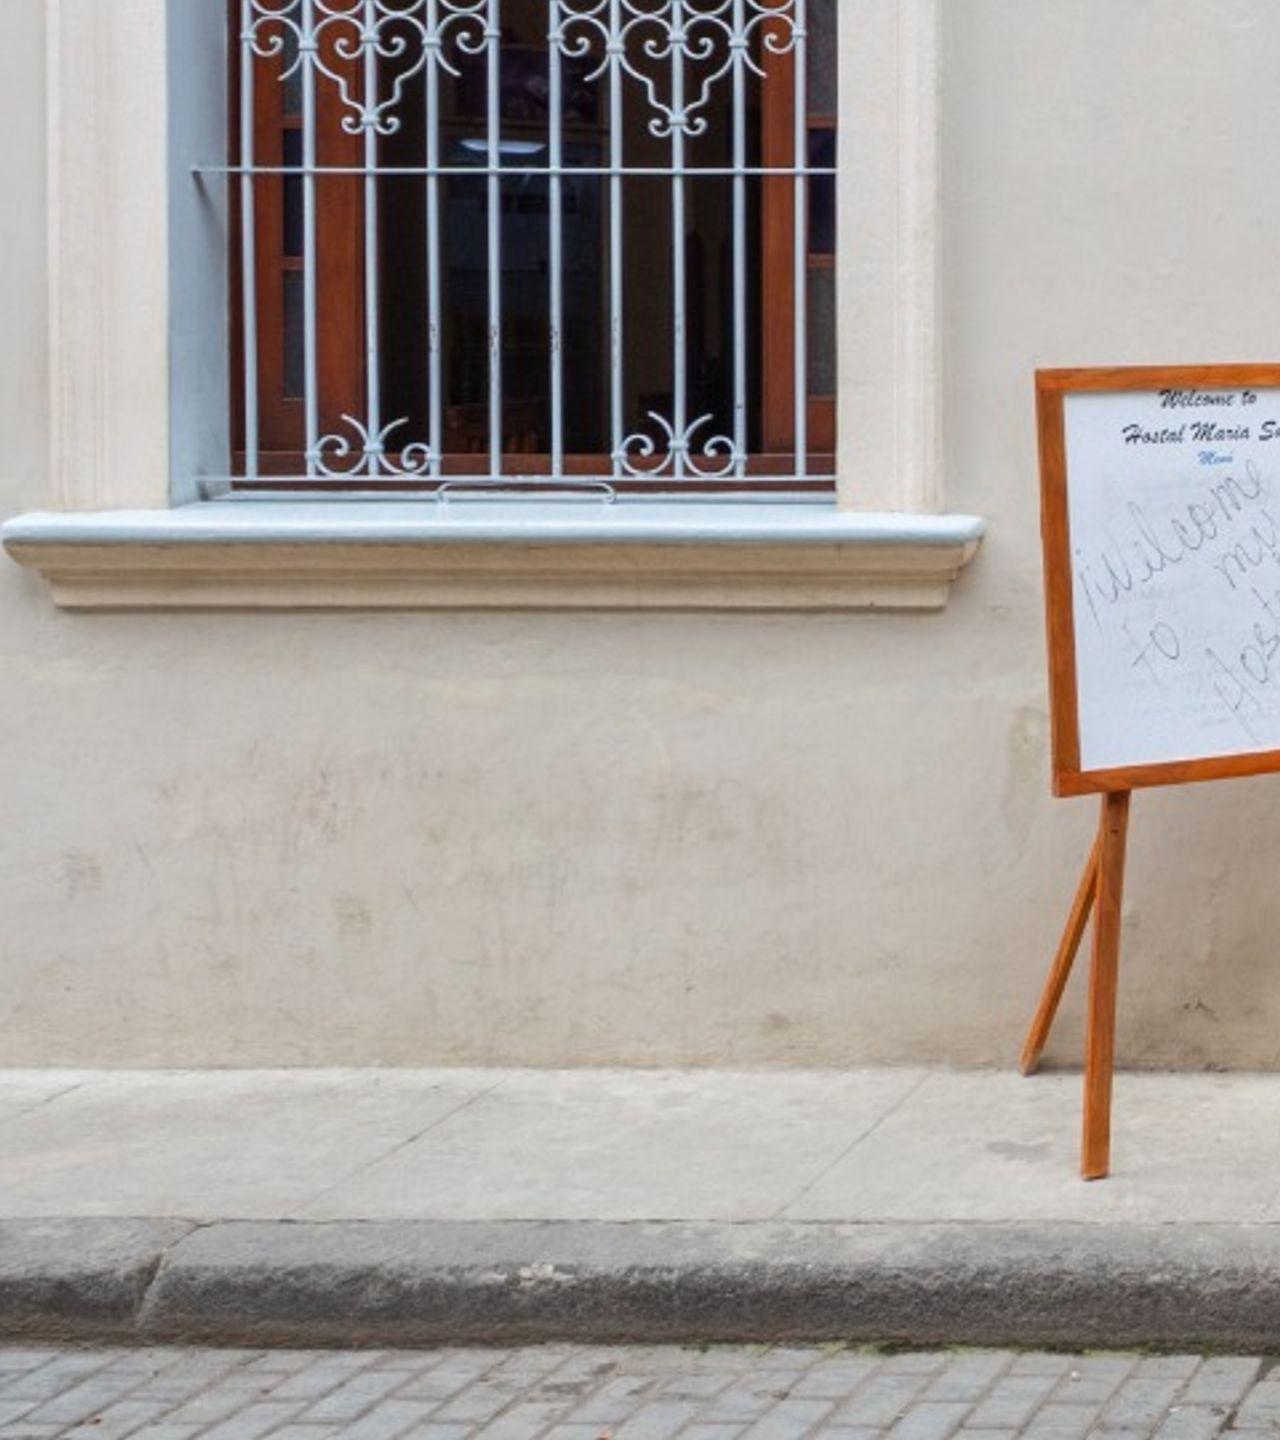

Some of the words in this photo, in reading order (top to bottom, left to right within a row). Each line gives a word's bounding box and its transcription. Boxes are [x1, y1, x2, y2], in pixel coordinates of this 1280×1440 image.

[1159, 389, 1236, 409] Welcome
[1242, 390, 1257, 407] to
[1122, 423, 1187, 446] Hostal
[1190, 421, 1250, 443] Maria
